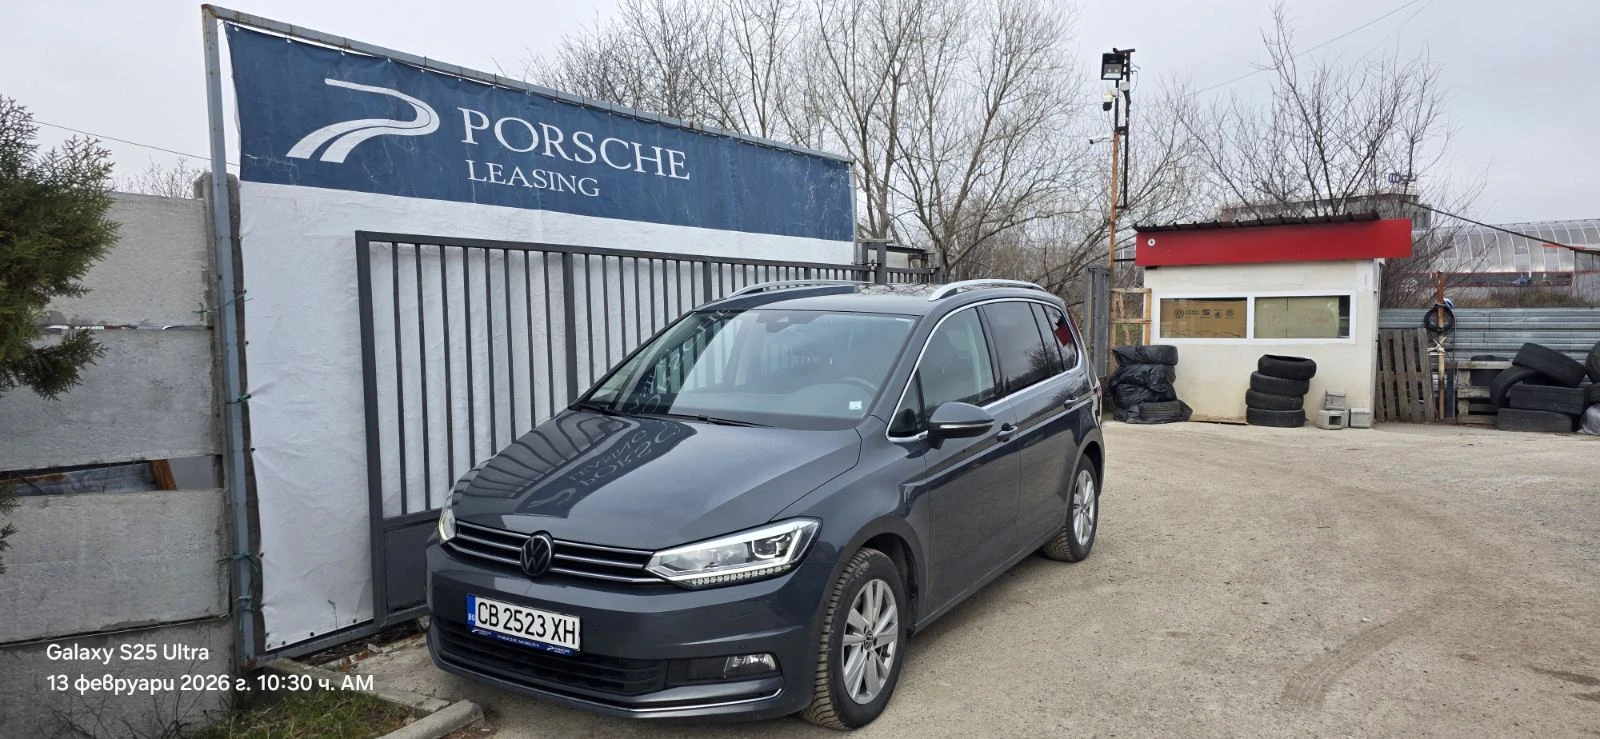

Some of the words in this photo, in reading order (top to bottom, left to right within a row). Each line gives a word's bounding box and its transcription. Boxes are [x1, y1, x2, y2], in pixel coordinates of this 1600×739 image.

[457, 106, 691, 180] PORSCHE
[465, 159, 600, 197] LEASING
[478, 601, 500, 628] CB
[503, 607, 547, 638] 2523
[551, 616, 576, 645] XH
